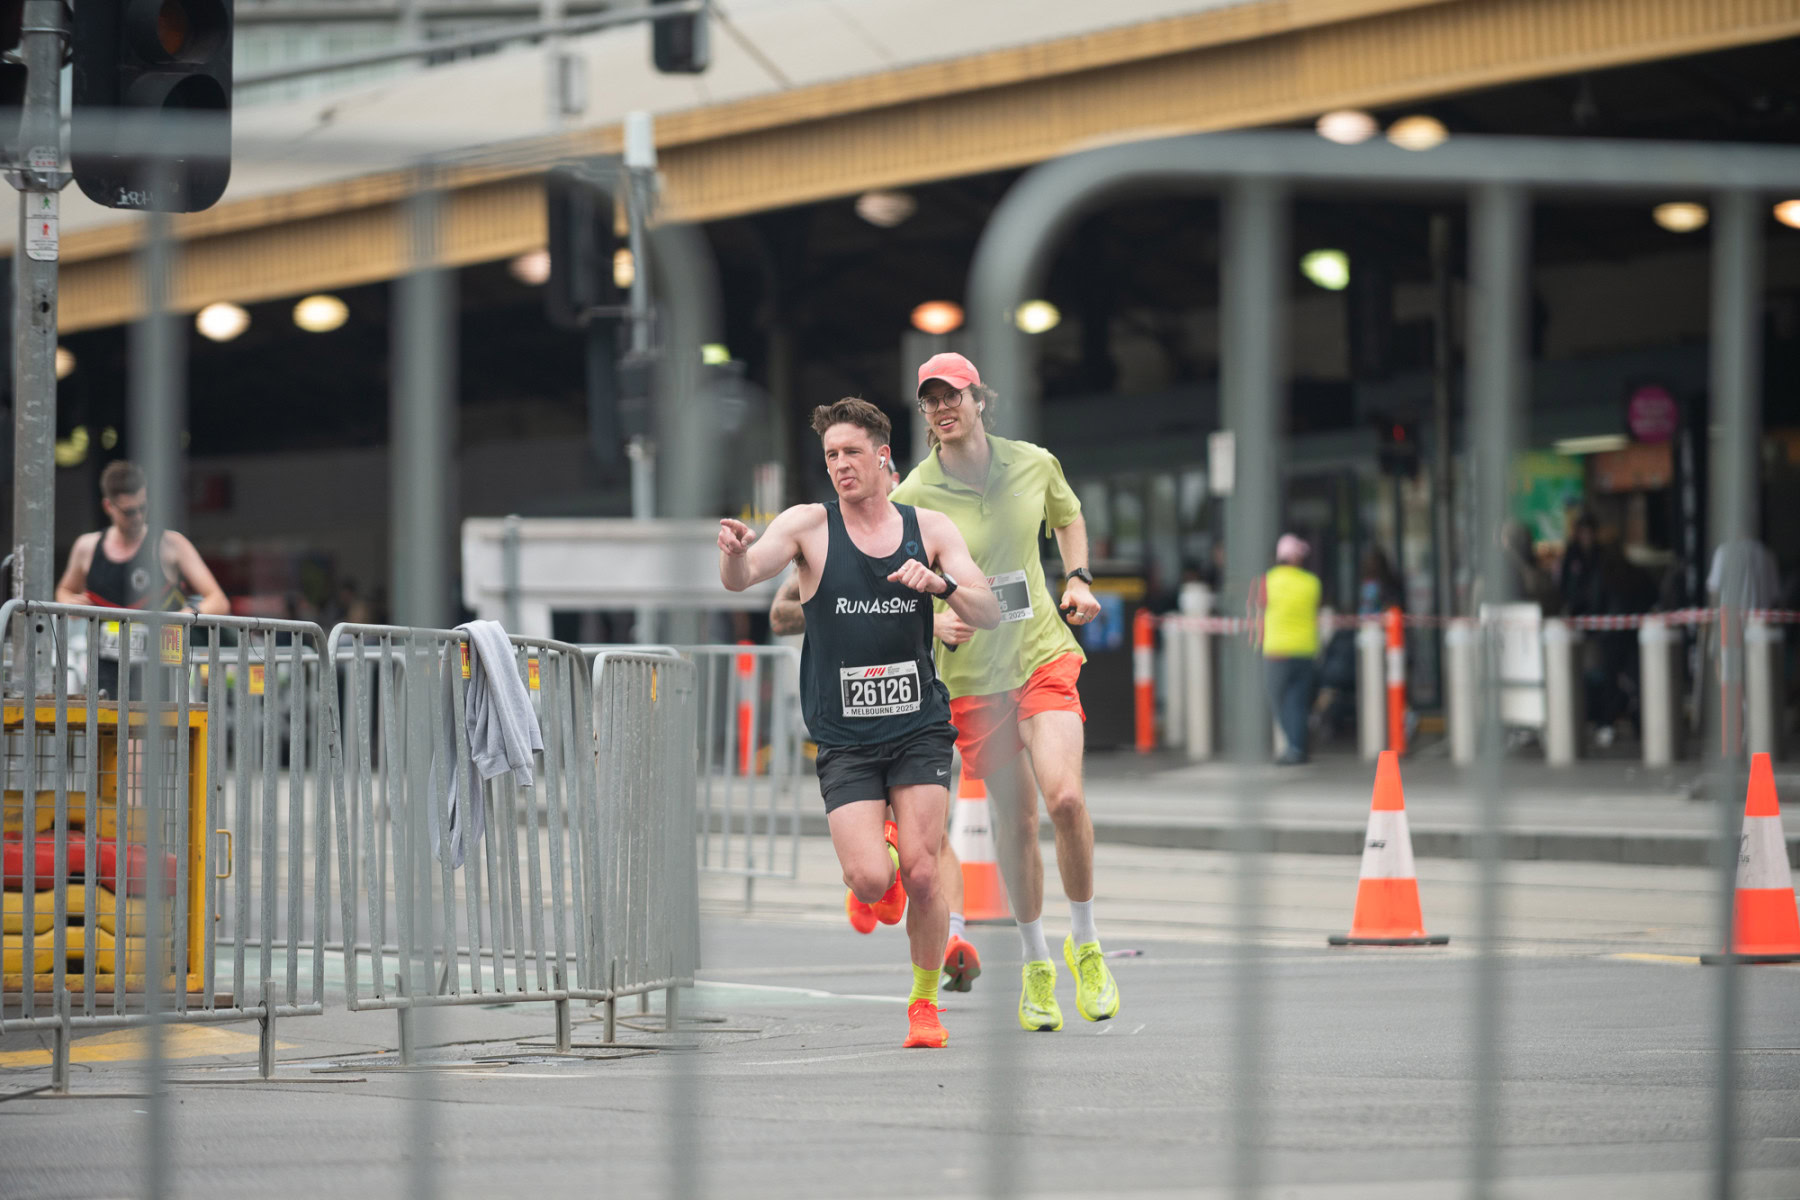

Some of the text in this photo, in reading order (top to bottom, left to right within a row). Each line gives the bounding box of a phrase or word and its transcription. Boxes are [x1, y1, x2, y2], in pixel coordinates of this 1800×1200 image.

[1008, 610, 1026, 620] 2025
[851, 676, 912, 706] 26126
[851, 704, 914, 716] MELBOURNE 2025
